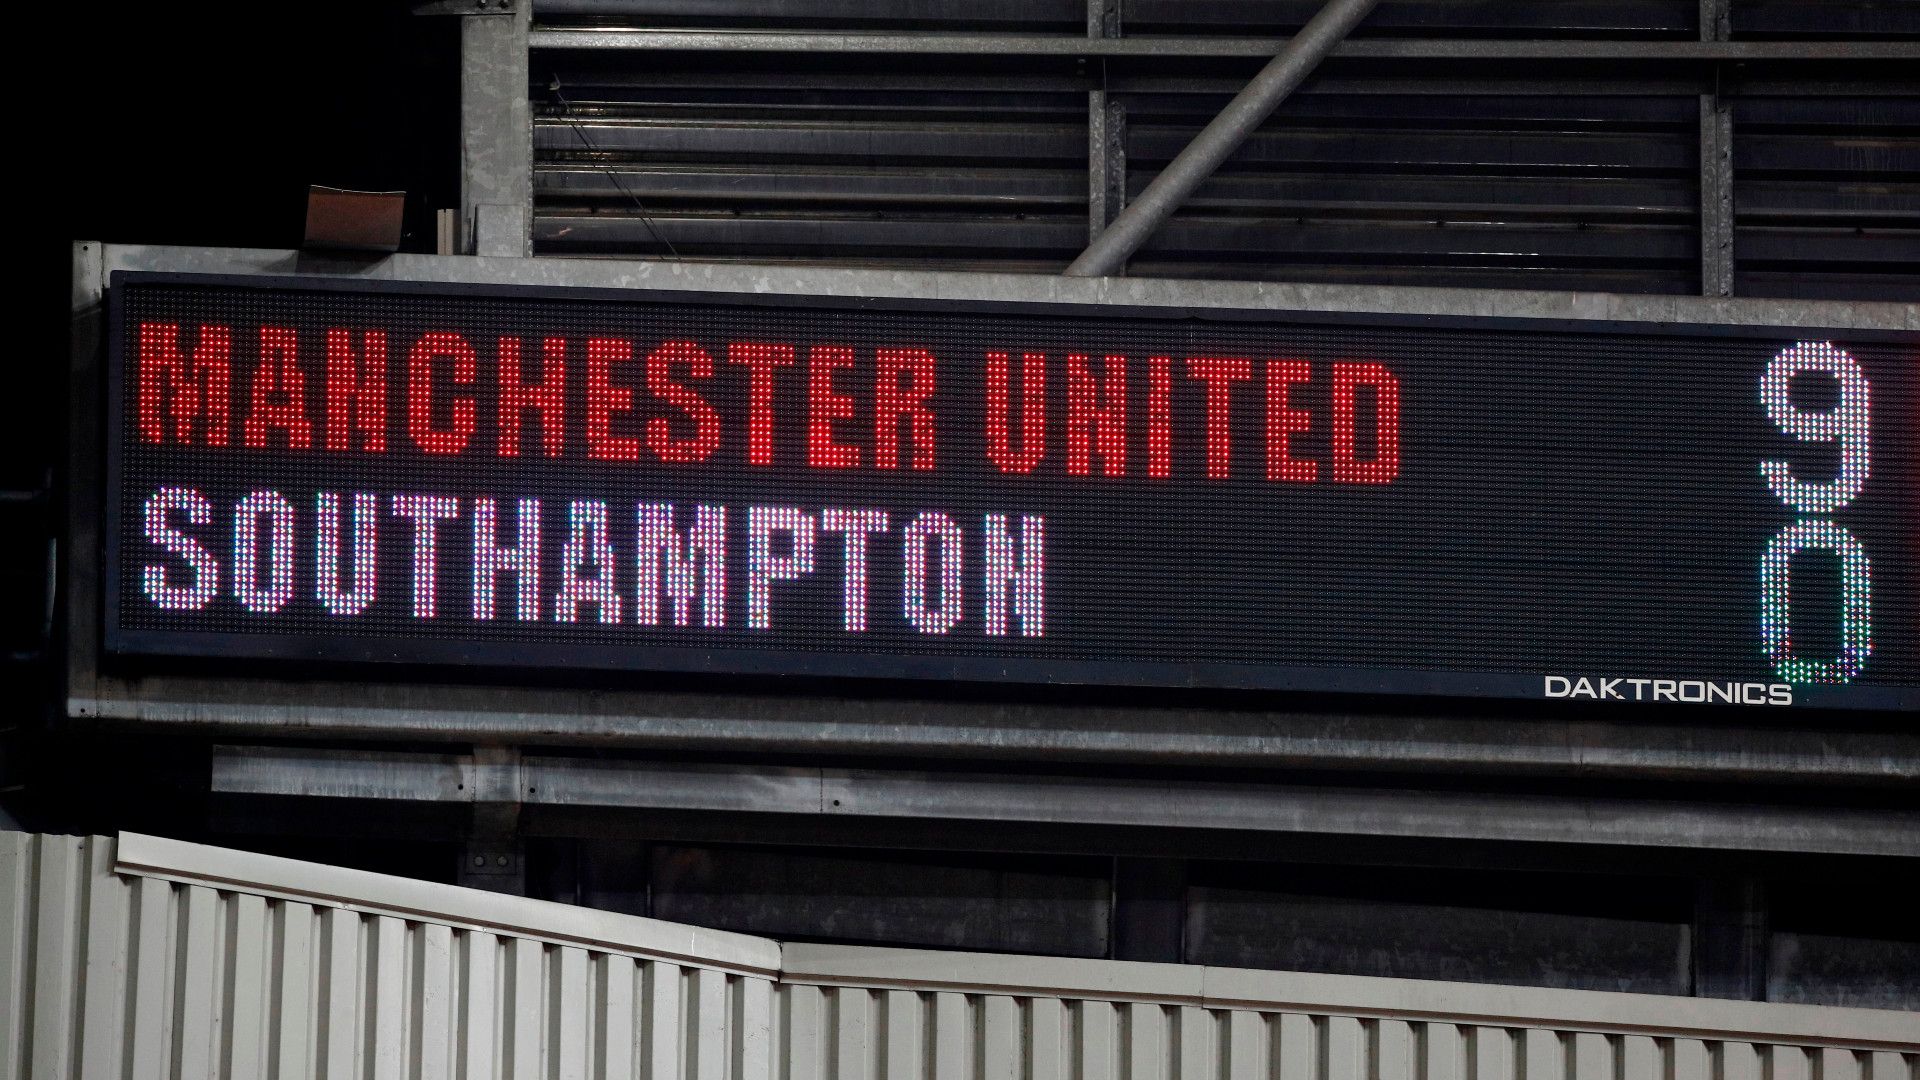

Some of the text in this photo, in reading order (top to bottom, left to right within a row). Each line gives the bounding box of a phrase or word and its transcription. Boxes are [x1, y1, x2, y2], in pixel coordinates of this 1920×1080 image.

[138, 322, 1871, 513] MANCHESTER UNITED 9
[143, 486, 1872, 684] SOUTHAMPTON 0
[1544, 675, 1793, 705] DAKTRONICS
